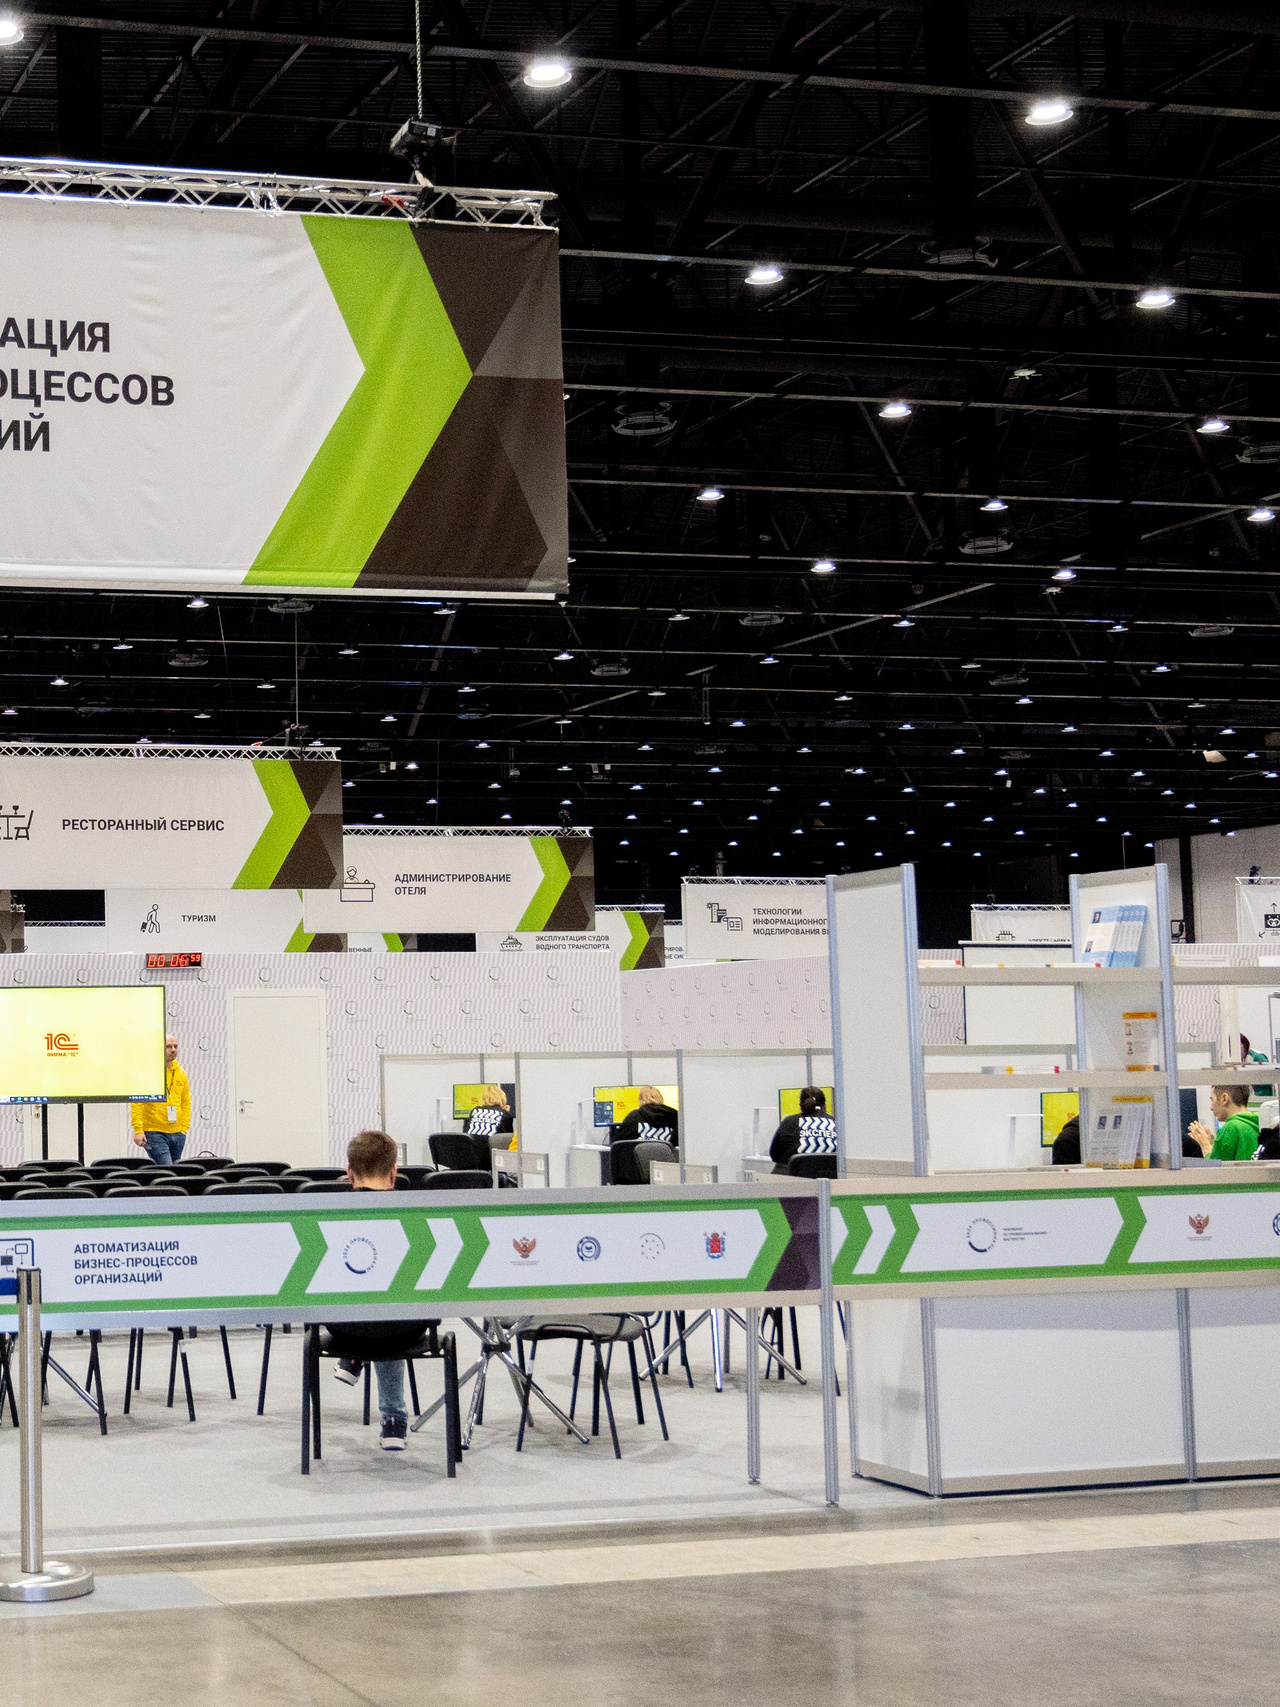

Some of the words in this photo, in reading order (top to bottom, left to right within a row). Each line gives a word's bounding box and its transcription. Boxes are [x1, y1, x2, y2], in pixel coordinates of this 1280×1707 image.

[62, 817, 167, 831] РЕСТОРАННЫЙ
[170, 819, 225, 831] СЕРВИС
[394, 873, 512, 884] АДМИНИСТРИРОВАНИЕ
[394, 886, 427, 896] ОТЕЛЯ
[753, 908, 802, 916] ТЕХНОЛОГИИ
[181, 914, 216, 923] ТУРИЗМ
[752, 918, 828, 927] ИНФОРМАЦИОННОГ
[753, 928, 821, 936] МОДЕЛИРОВАНИЯ
[535, 935, 586, 943] ЭКСПЛУАТАЦИЯ
[587, 935, 610, 943] СУДОВ
[535, 943, 566, 951] ВОДНОГО
[147, 954, 166, 968] 00
[169, 954, 188, 968] 06
[44, 1033, 79, 1051] 1С
[799, 1129, 837, 1139] ЭКСПЕР
[74, 1240, 180, 1255] АВТОМАТИЗАЦИЯ
[74, 1254, 198, 1270] БИЗНЕС-ПРОЦЕССОВ
[74, 1269, 163, 1286] ОРГАНИЗАЦИЙ
